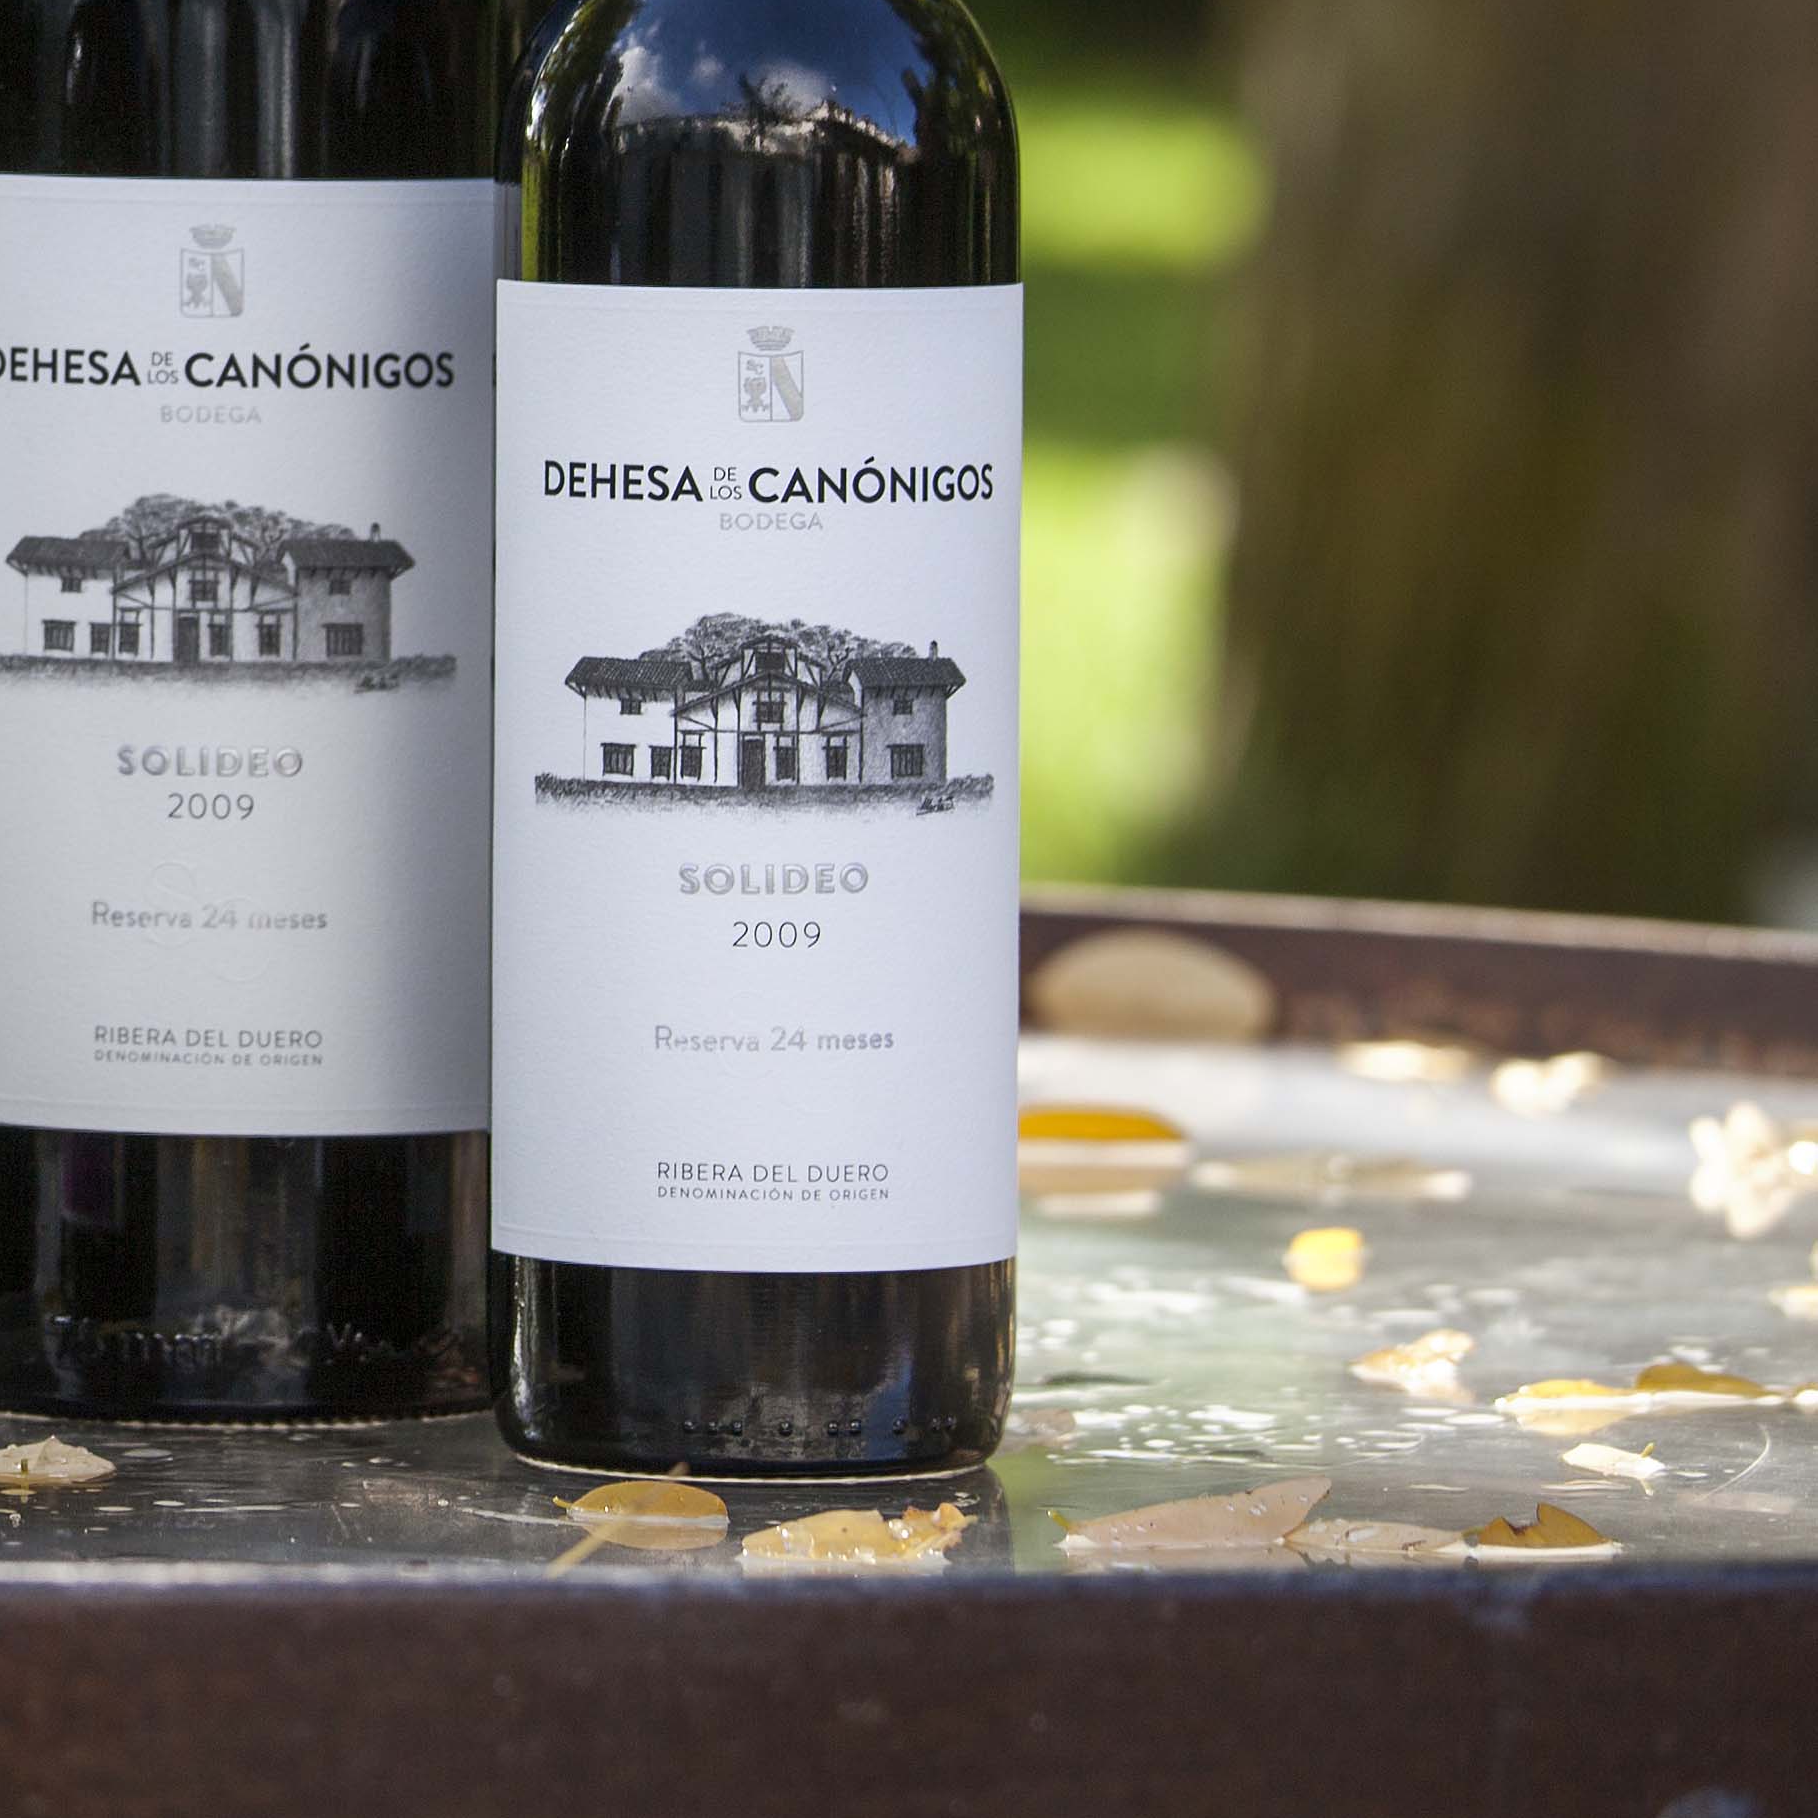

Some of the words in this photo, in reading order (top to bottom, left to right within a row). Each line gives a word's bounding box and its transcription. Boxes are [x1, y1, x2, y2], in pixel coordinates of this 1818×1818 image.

[151, 352, 174, 366] DE
[184, 343, 455, 389] CANÓNIGOS
[147, 369, 180, 385] LOS
[160, 404, 262, 424] BODEGA
[544, 460, 703, 502] DEHESA
[713, 467, 737, 481] DE
[748, 456, 994, 504] CANÓNIGOS
[709, 484, 743, 501] LOS
[719, 511, 824, 532] BODEGA
[116, 745, 304, 779] SOLIDEO
[167, 792, 255, 820] 2009
[678, 862, 870, 895] SOLIDEO
[91, 900, 193, 930] Reserva
[201, 903, 238, 930] 24
[248, 909, 329, 931] meses
[732, 921, 821, 949] 2009
[94, 1025, 177, 1047] RIBERA
[185, 1029, 229, 1048] DEL
[238, 1030, 323, 1049] DUERO
[654, 1024, 760, 1052] Reserva
[770, 1025, 808, 1052] 24
[817, 1031, 895, 1051] meses
[93, 1049, 226, 1066] DENOMINACIÓN
[231, 1053, 253, 1067] DE
[259, 1053, 324, 1067] ORIGEN
[657, 1162, 743, 1182] RIBERA
[753, 1164, 798, 1183] DEL
[807, 1164, 889, 1183] DUERO
[657, 1185, 794, 1202] DENOMINACIÓN
[801, 1189, 822, 1202] DE
[829, 1188, 890, 1202] ORIGEN
